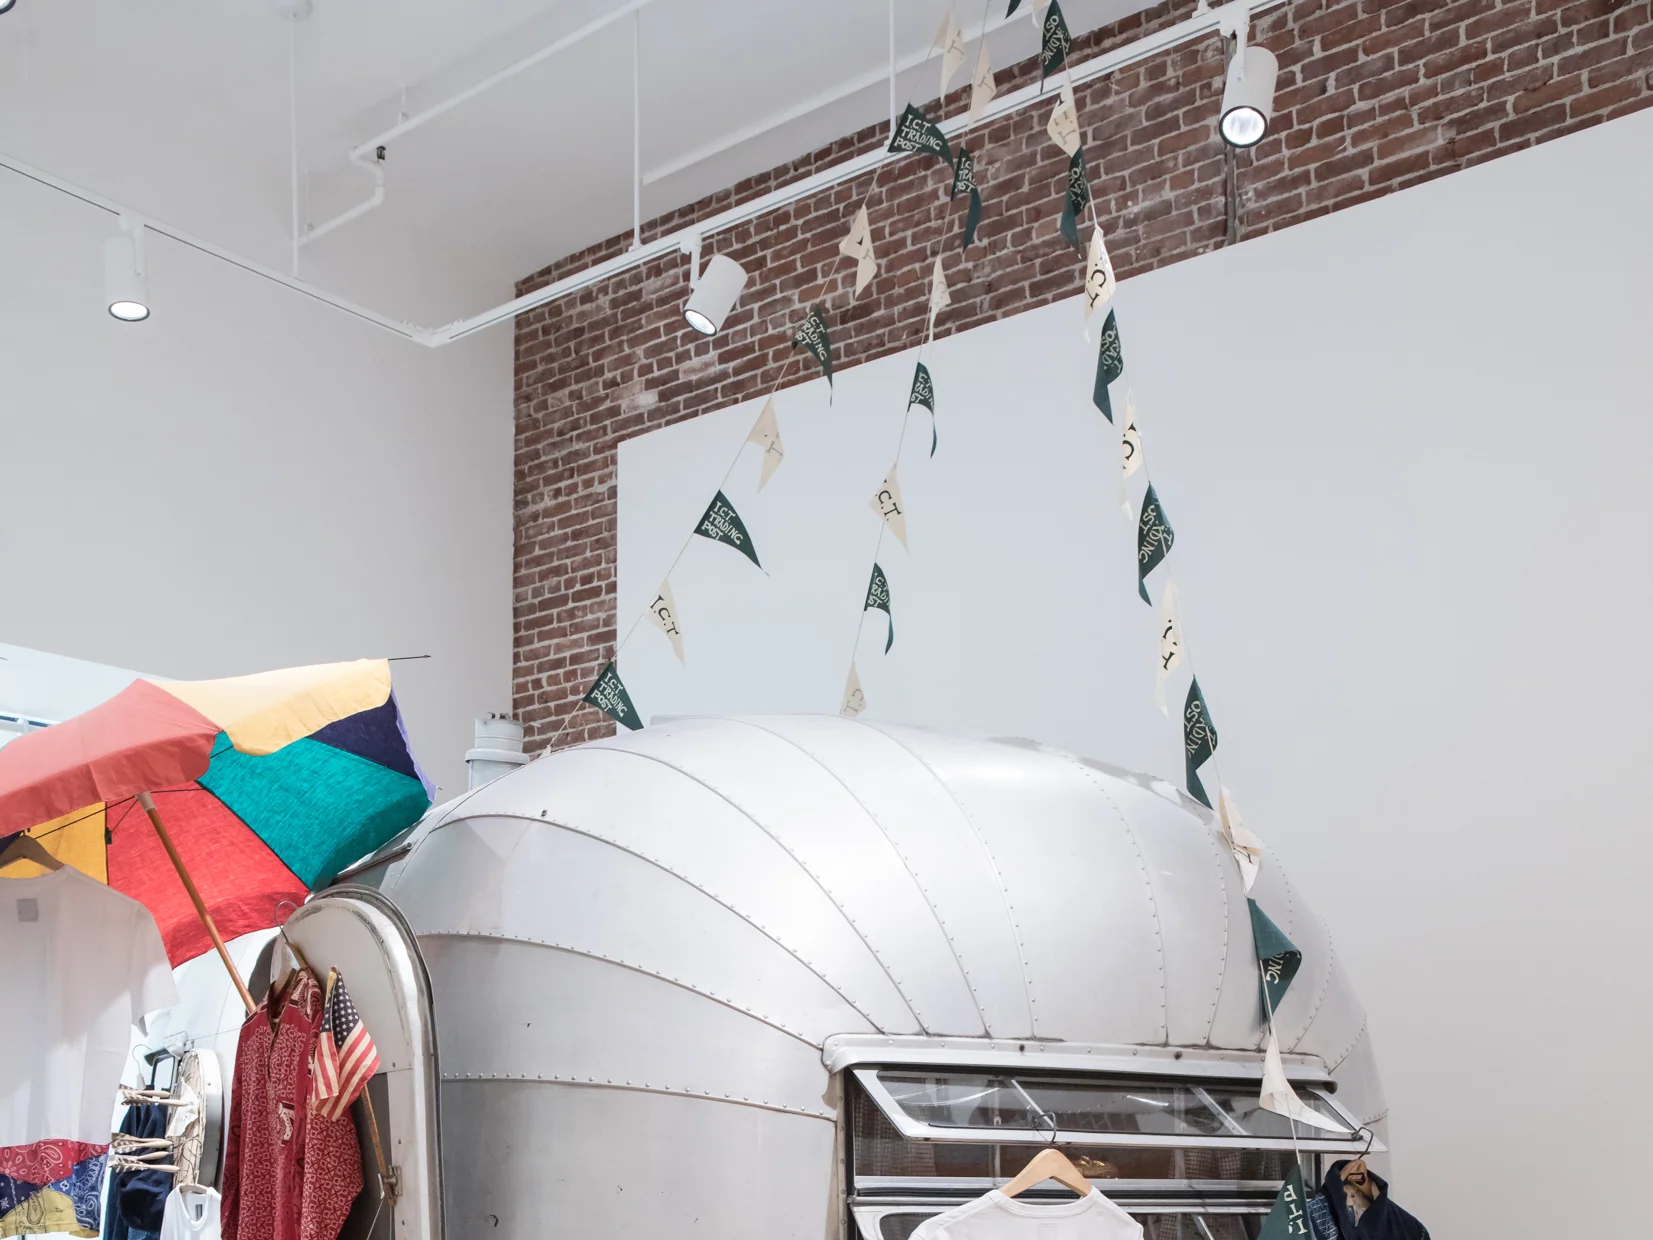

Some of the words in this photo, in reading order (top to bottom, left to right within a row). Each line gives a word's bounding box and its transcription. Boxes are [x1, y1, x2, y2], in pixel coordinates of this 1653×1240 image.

[894, 136, 921, 152] POST
[901, 126, 942, 151] TRADING
[701, 520, 723, 540] POST
[709, 511, 743, 545] TRADING
[591, 689, 612, 711] POST
[599, 681, 627, 717] TRADING
